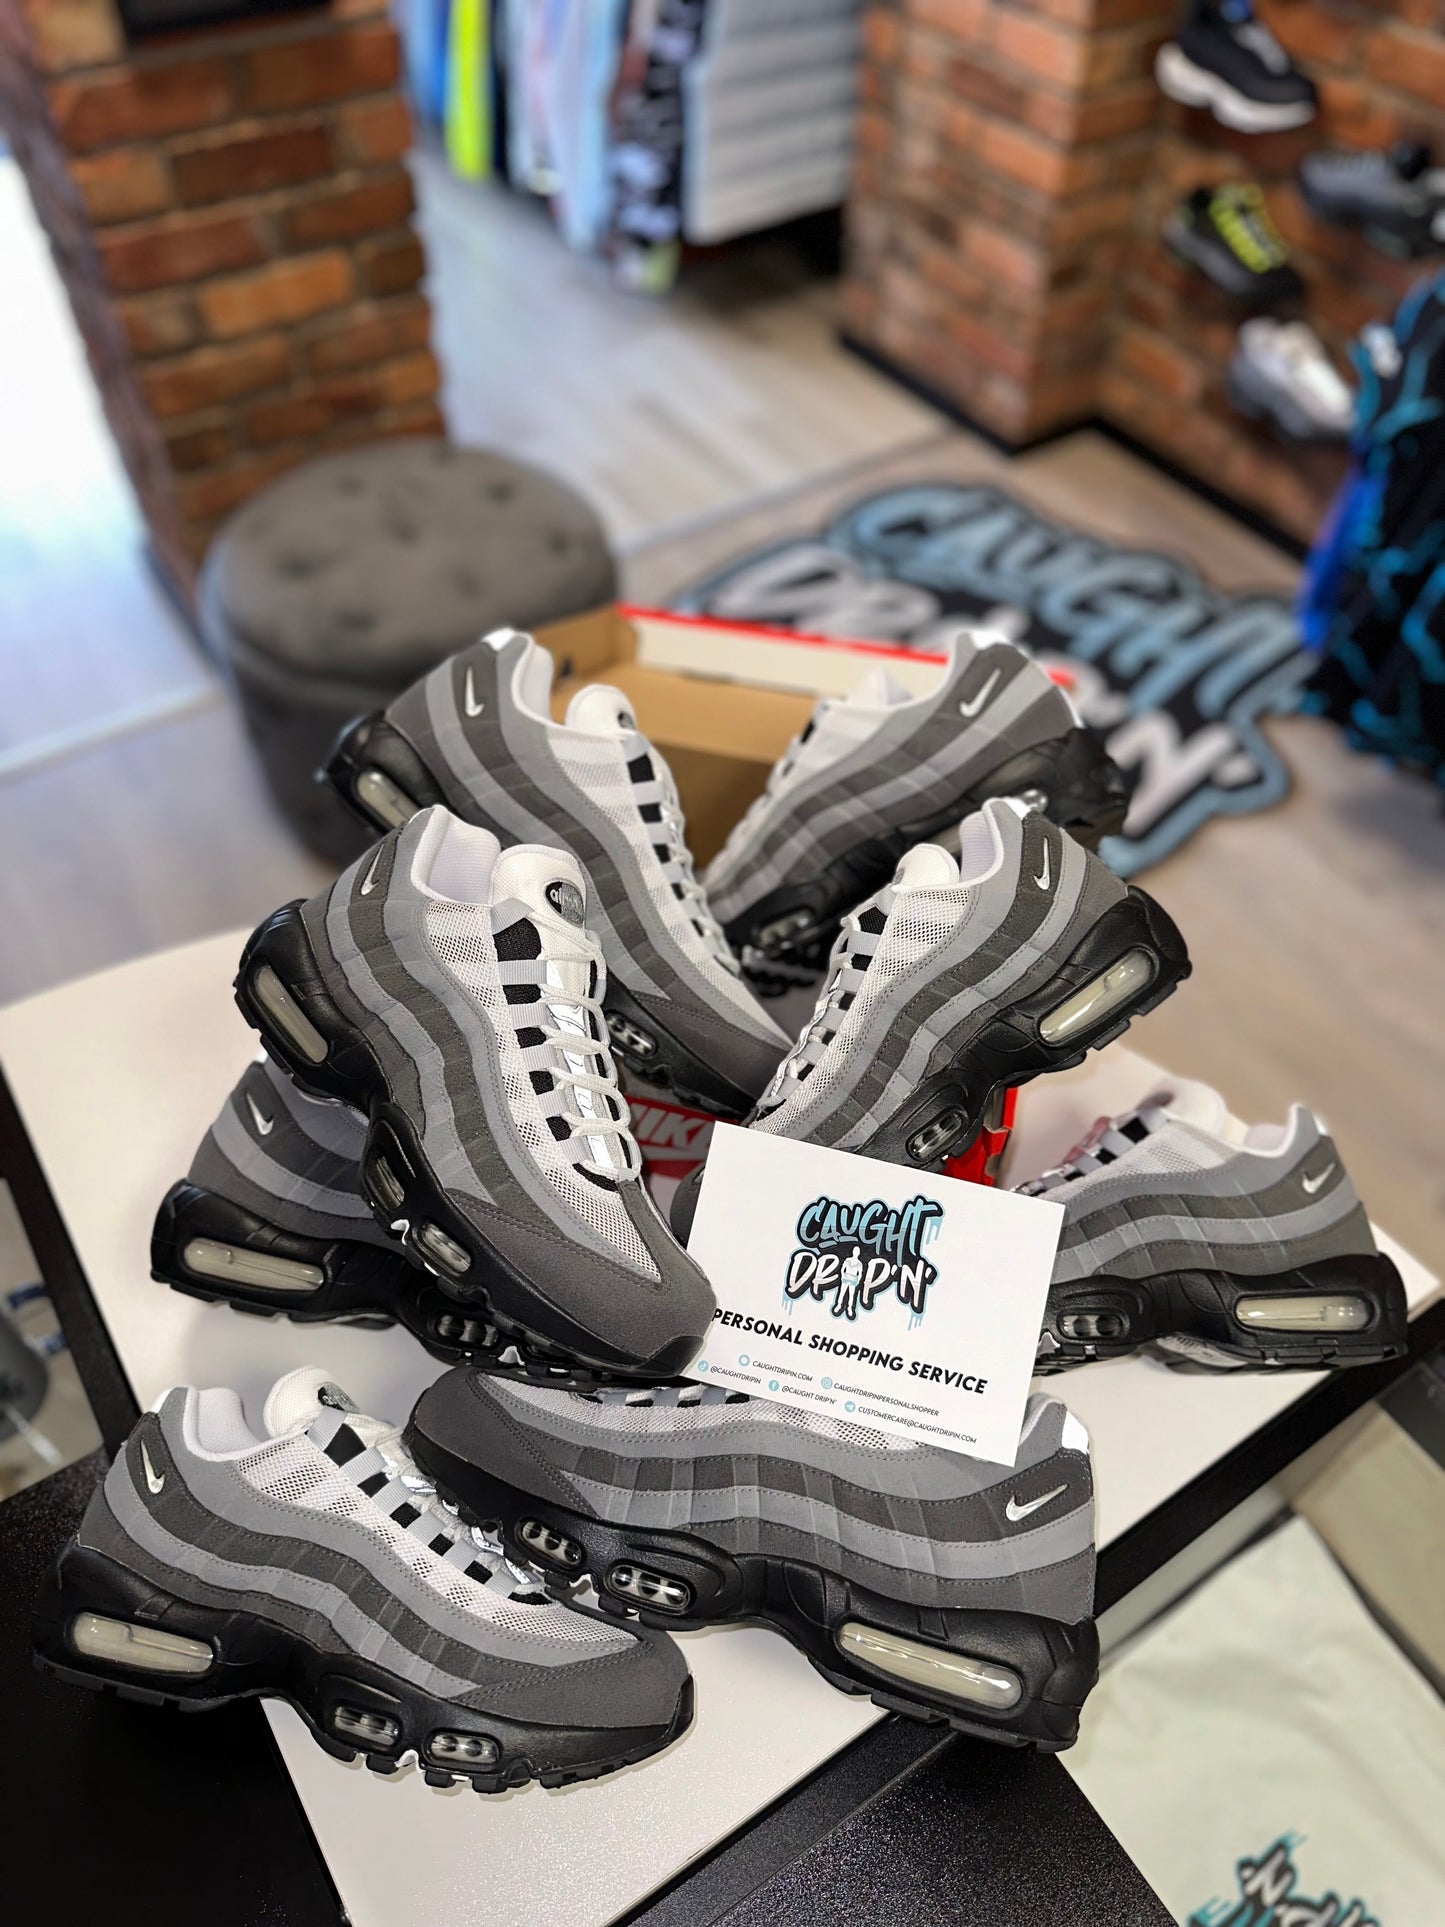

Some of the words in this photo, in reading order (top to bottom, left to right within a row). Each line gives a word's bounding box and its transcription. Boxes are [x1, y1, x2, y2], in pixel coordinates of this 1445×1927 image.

[798, 1197, 942, 1267] CAUGHT
[711, 1308, 803, 1345] PERSONAL
[808, 1334, 904, 1371] SHOPPING
[908, 1361, 988, 1394] SERVICE
[710, 1366, 761, 1385] @CAUGHTDRIPIN
[752, 1360, 813, 1382] CAUGHTDRIPIN.COM
[782, 1385, 814, 1400] @CAUGHT
[834, 1382, 939, 1417] CAUGHTDRIPINPERSONALSHOPPER
[858, 1406, 977, 1444] CUSTOMERCARE@CAUGHTDRIPIN.COM
